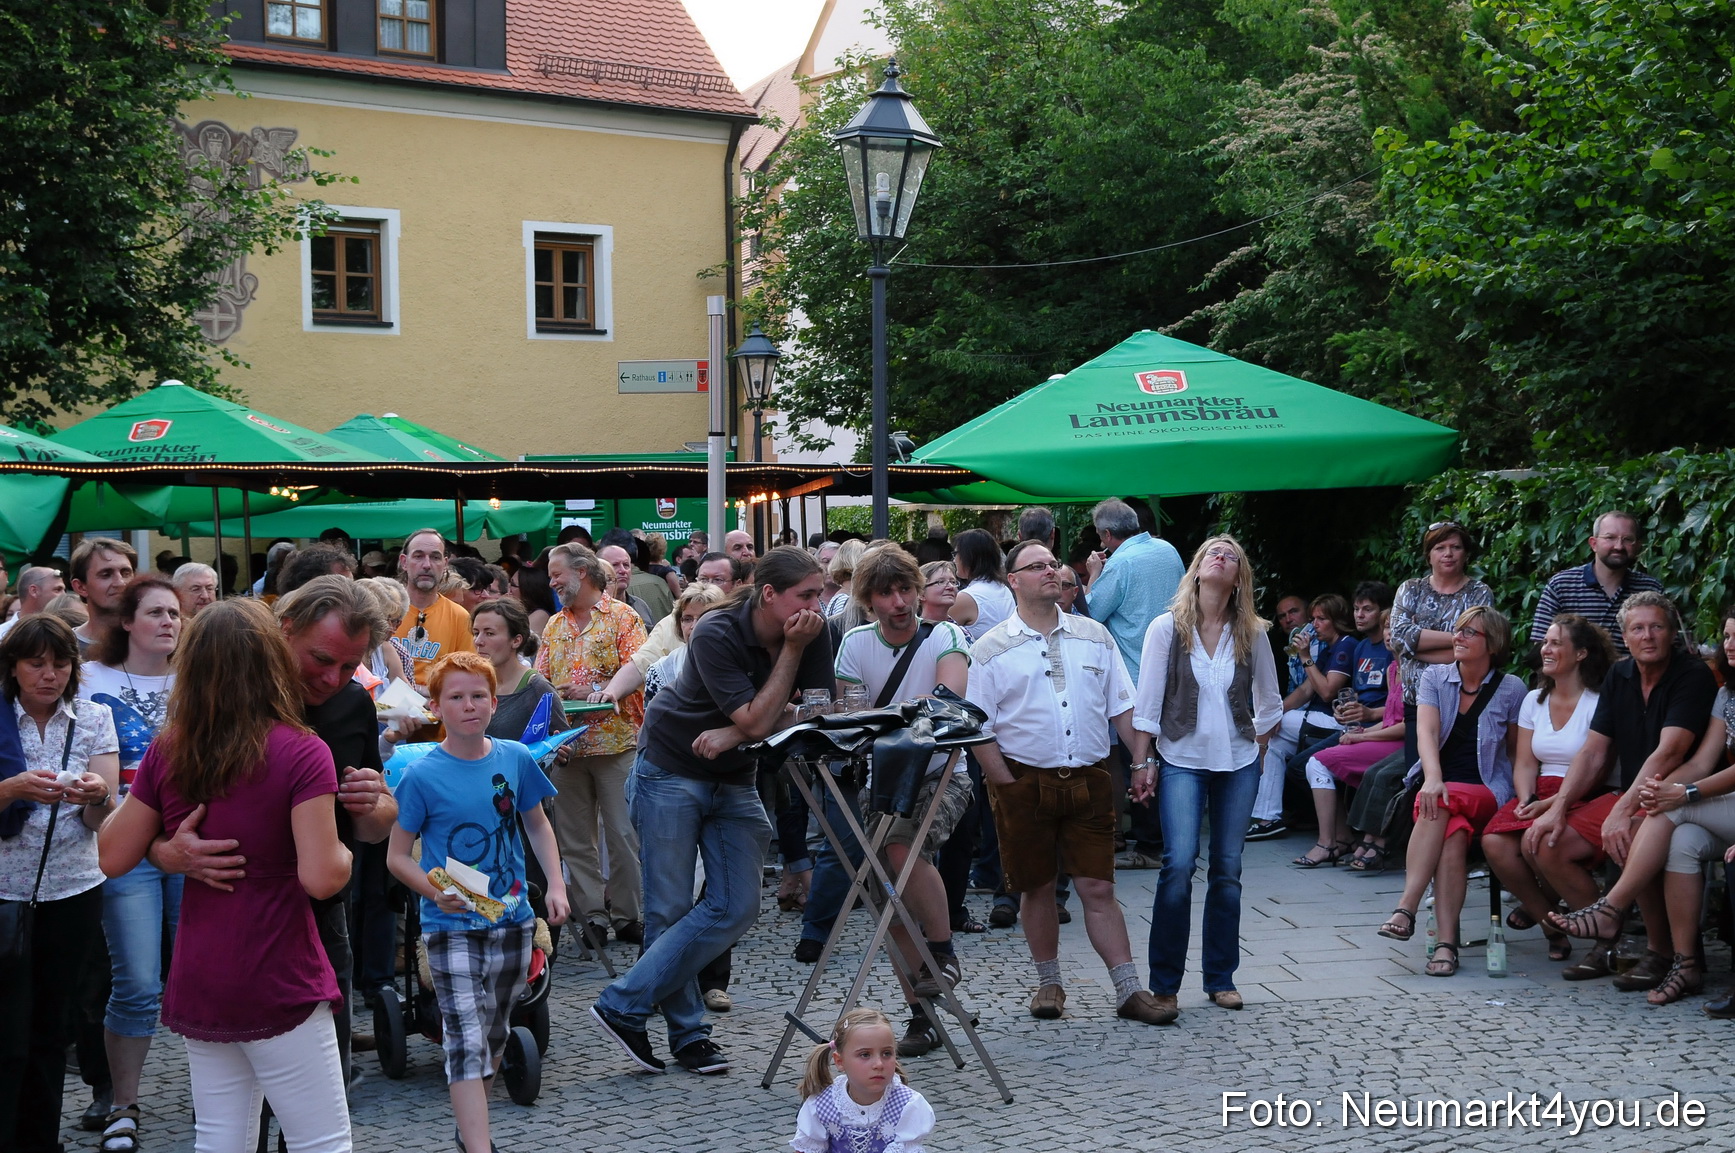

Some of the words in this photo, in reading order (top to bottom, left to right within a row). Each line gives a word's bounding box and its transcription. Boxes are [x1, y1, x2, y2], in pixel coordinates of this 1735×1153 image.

[631, 373, 656, 382] Rathaus
[1095, 396, 1245, 413] Neumarkter
[1068, 406, 1280, 429] Lammsbräu
[1149, 424, 1251, 434] ÖKOLOGISCHE
[642, 520, 692, 530] Neumarkter
